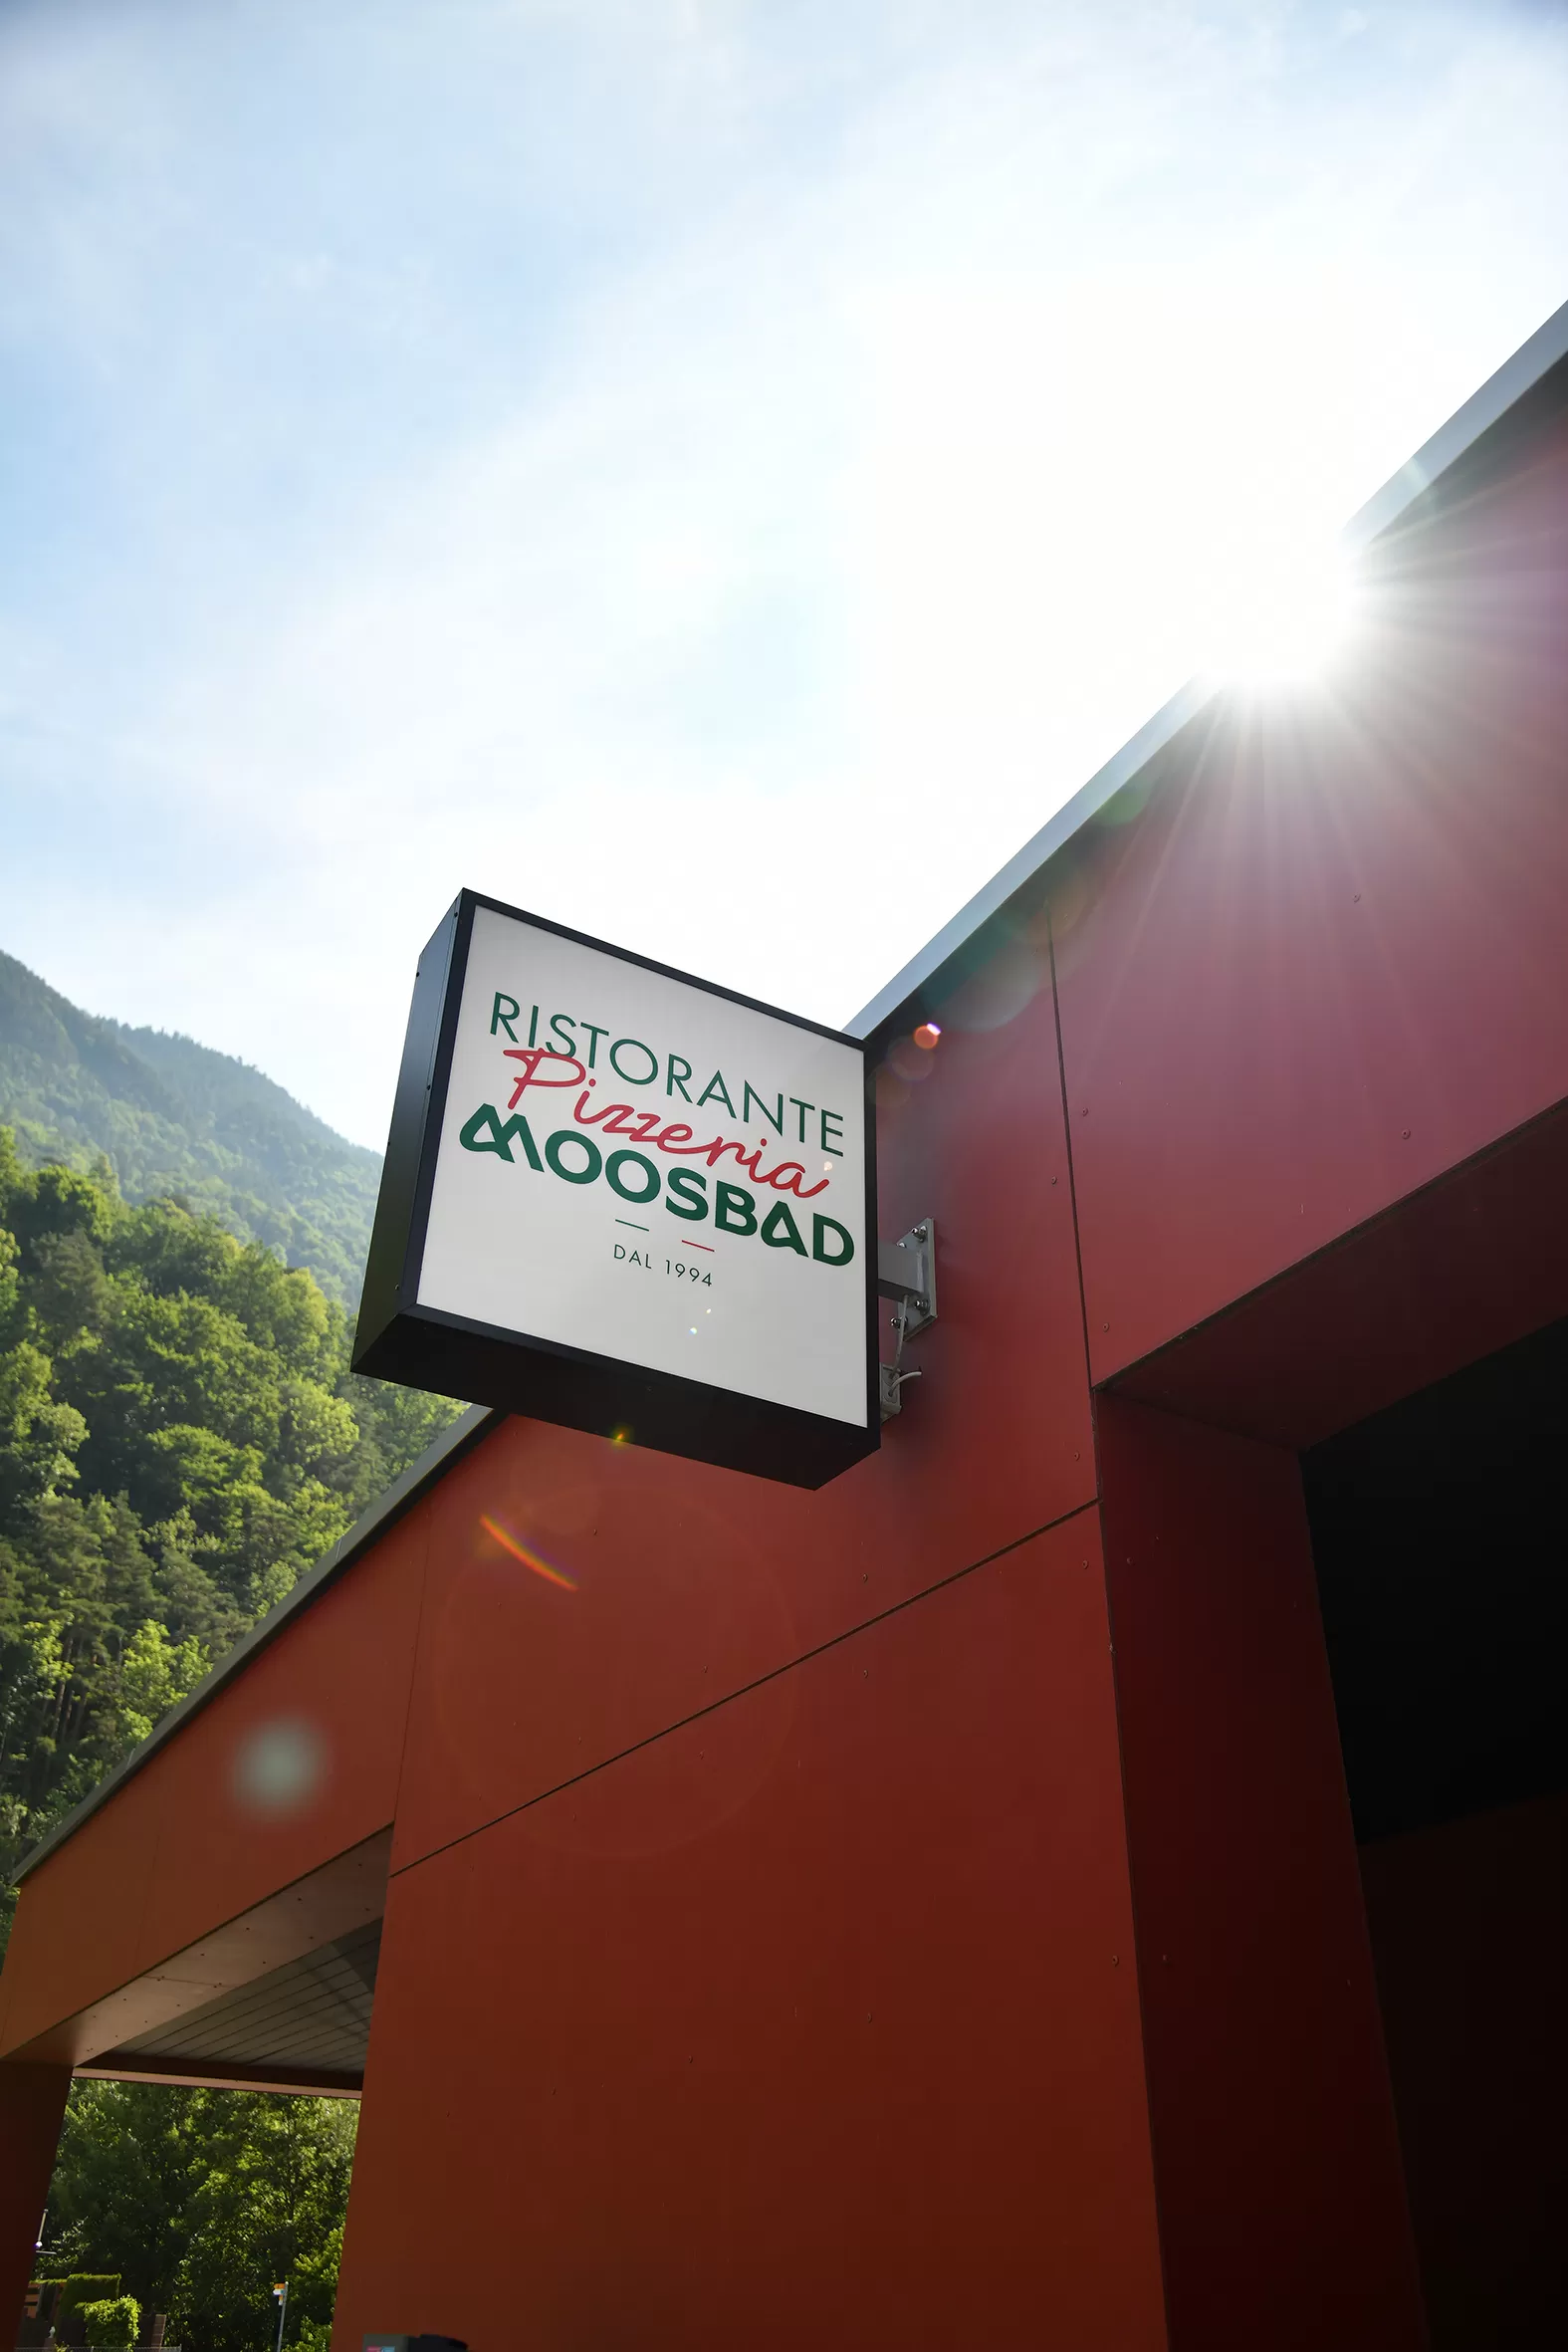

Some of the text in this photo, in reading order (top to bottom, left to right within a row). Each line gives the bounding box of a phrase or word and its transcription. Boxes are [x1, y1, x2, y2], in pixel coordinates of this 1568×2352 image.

[489, 991, 844, 1158] RISTORANTE
[503, 1048, 830, 1199] Pizzeria
[459, 1102, 855, 1267] MOOSBAD
[612, 1244, 713, 1288] DAL 1994
